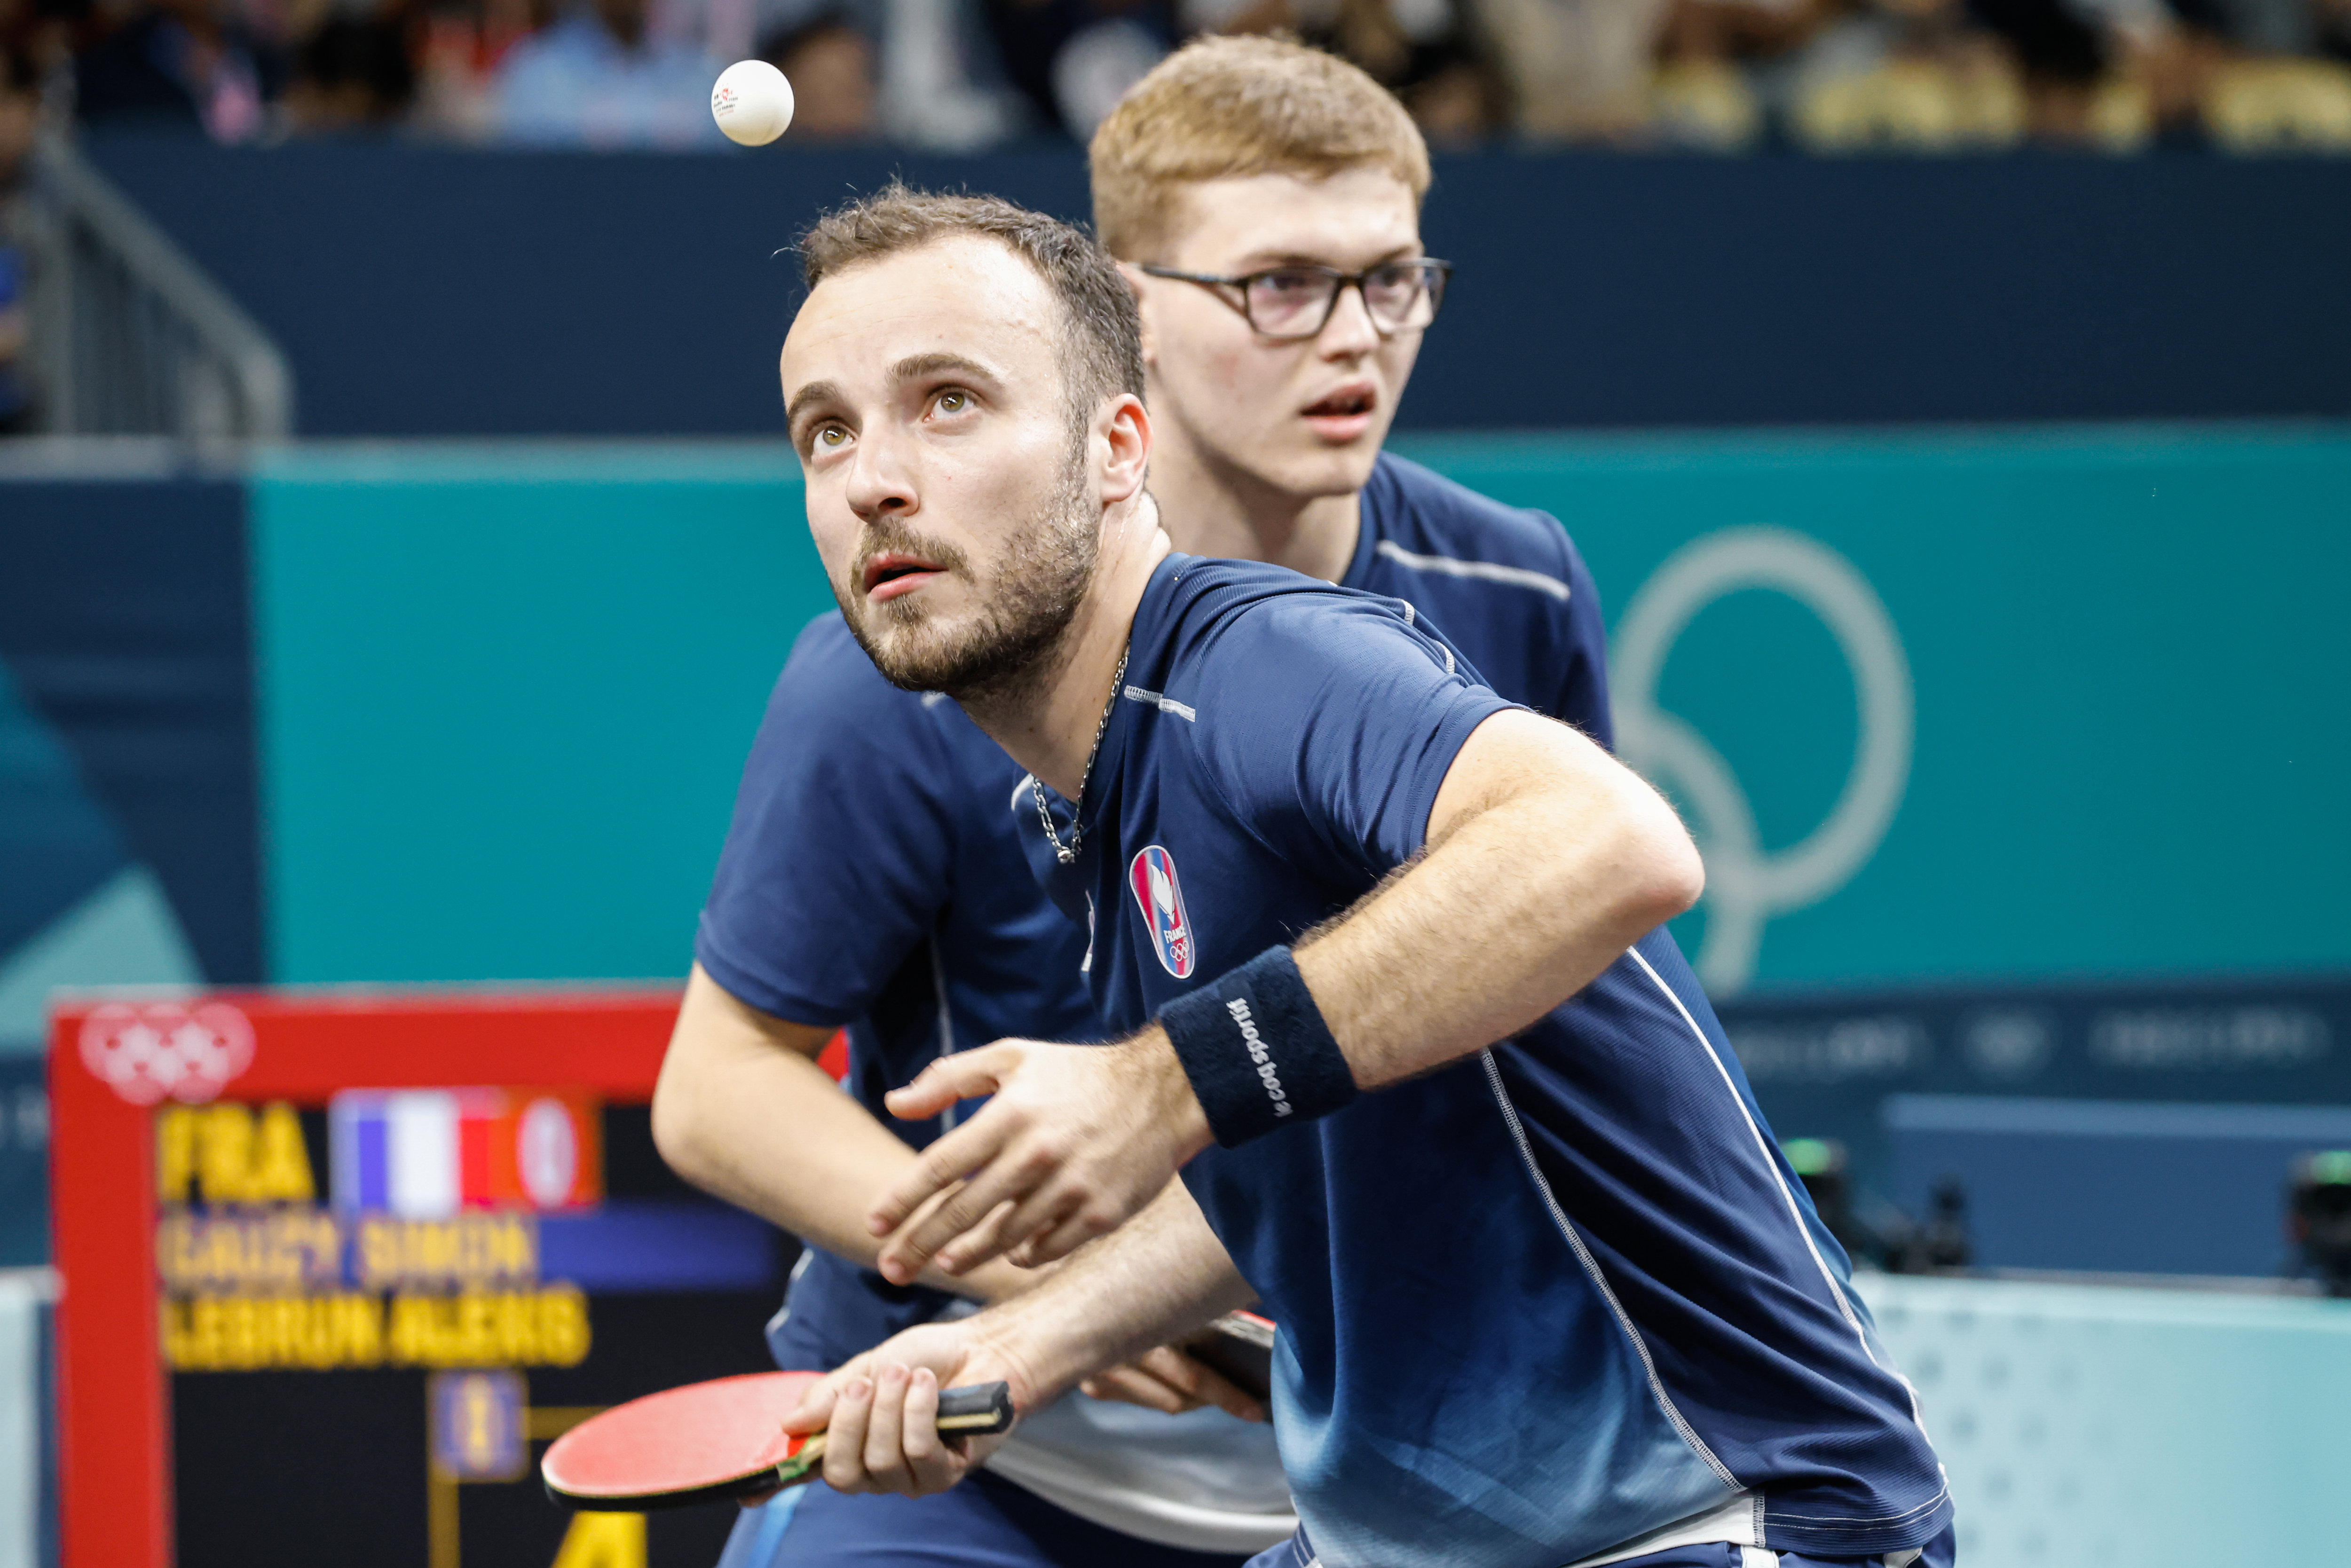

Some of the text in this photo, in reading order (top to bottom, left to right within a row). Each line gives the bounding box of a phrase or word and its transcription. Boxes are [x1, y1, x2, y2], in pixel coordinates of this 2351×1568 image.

[1163, 923, 1186, 944] FRANCE
[1225, 997, 1270, 1065] sportif
[1256, 1061, 1286, 1101] coq
[158, 1104, 314, 1199] FRA
